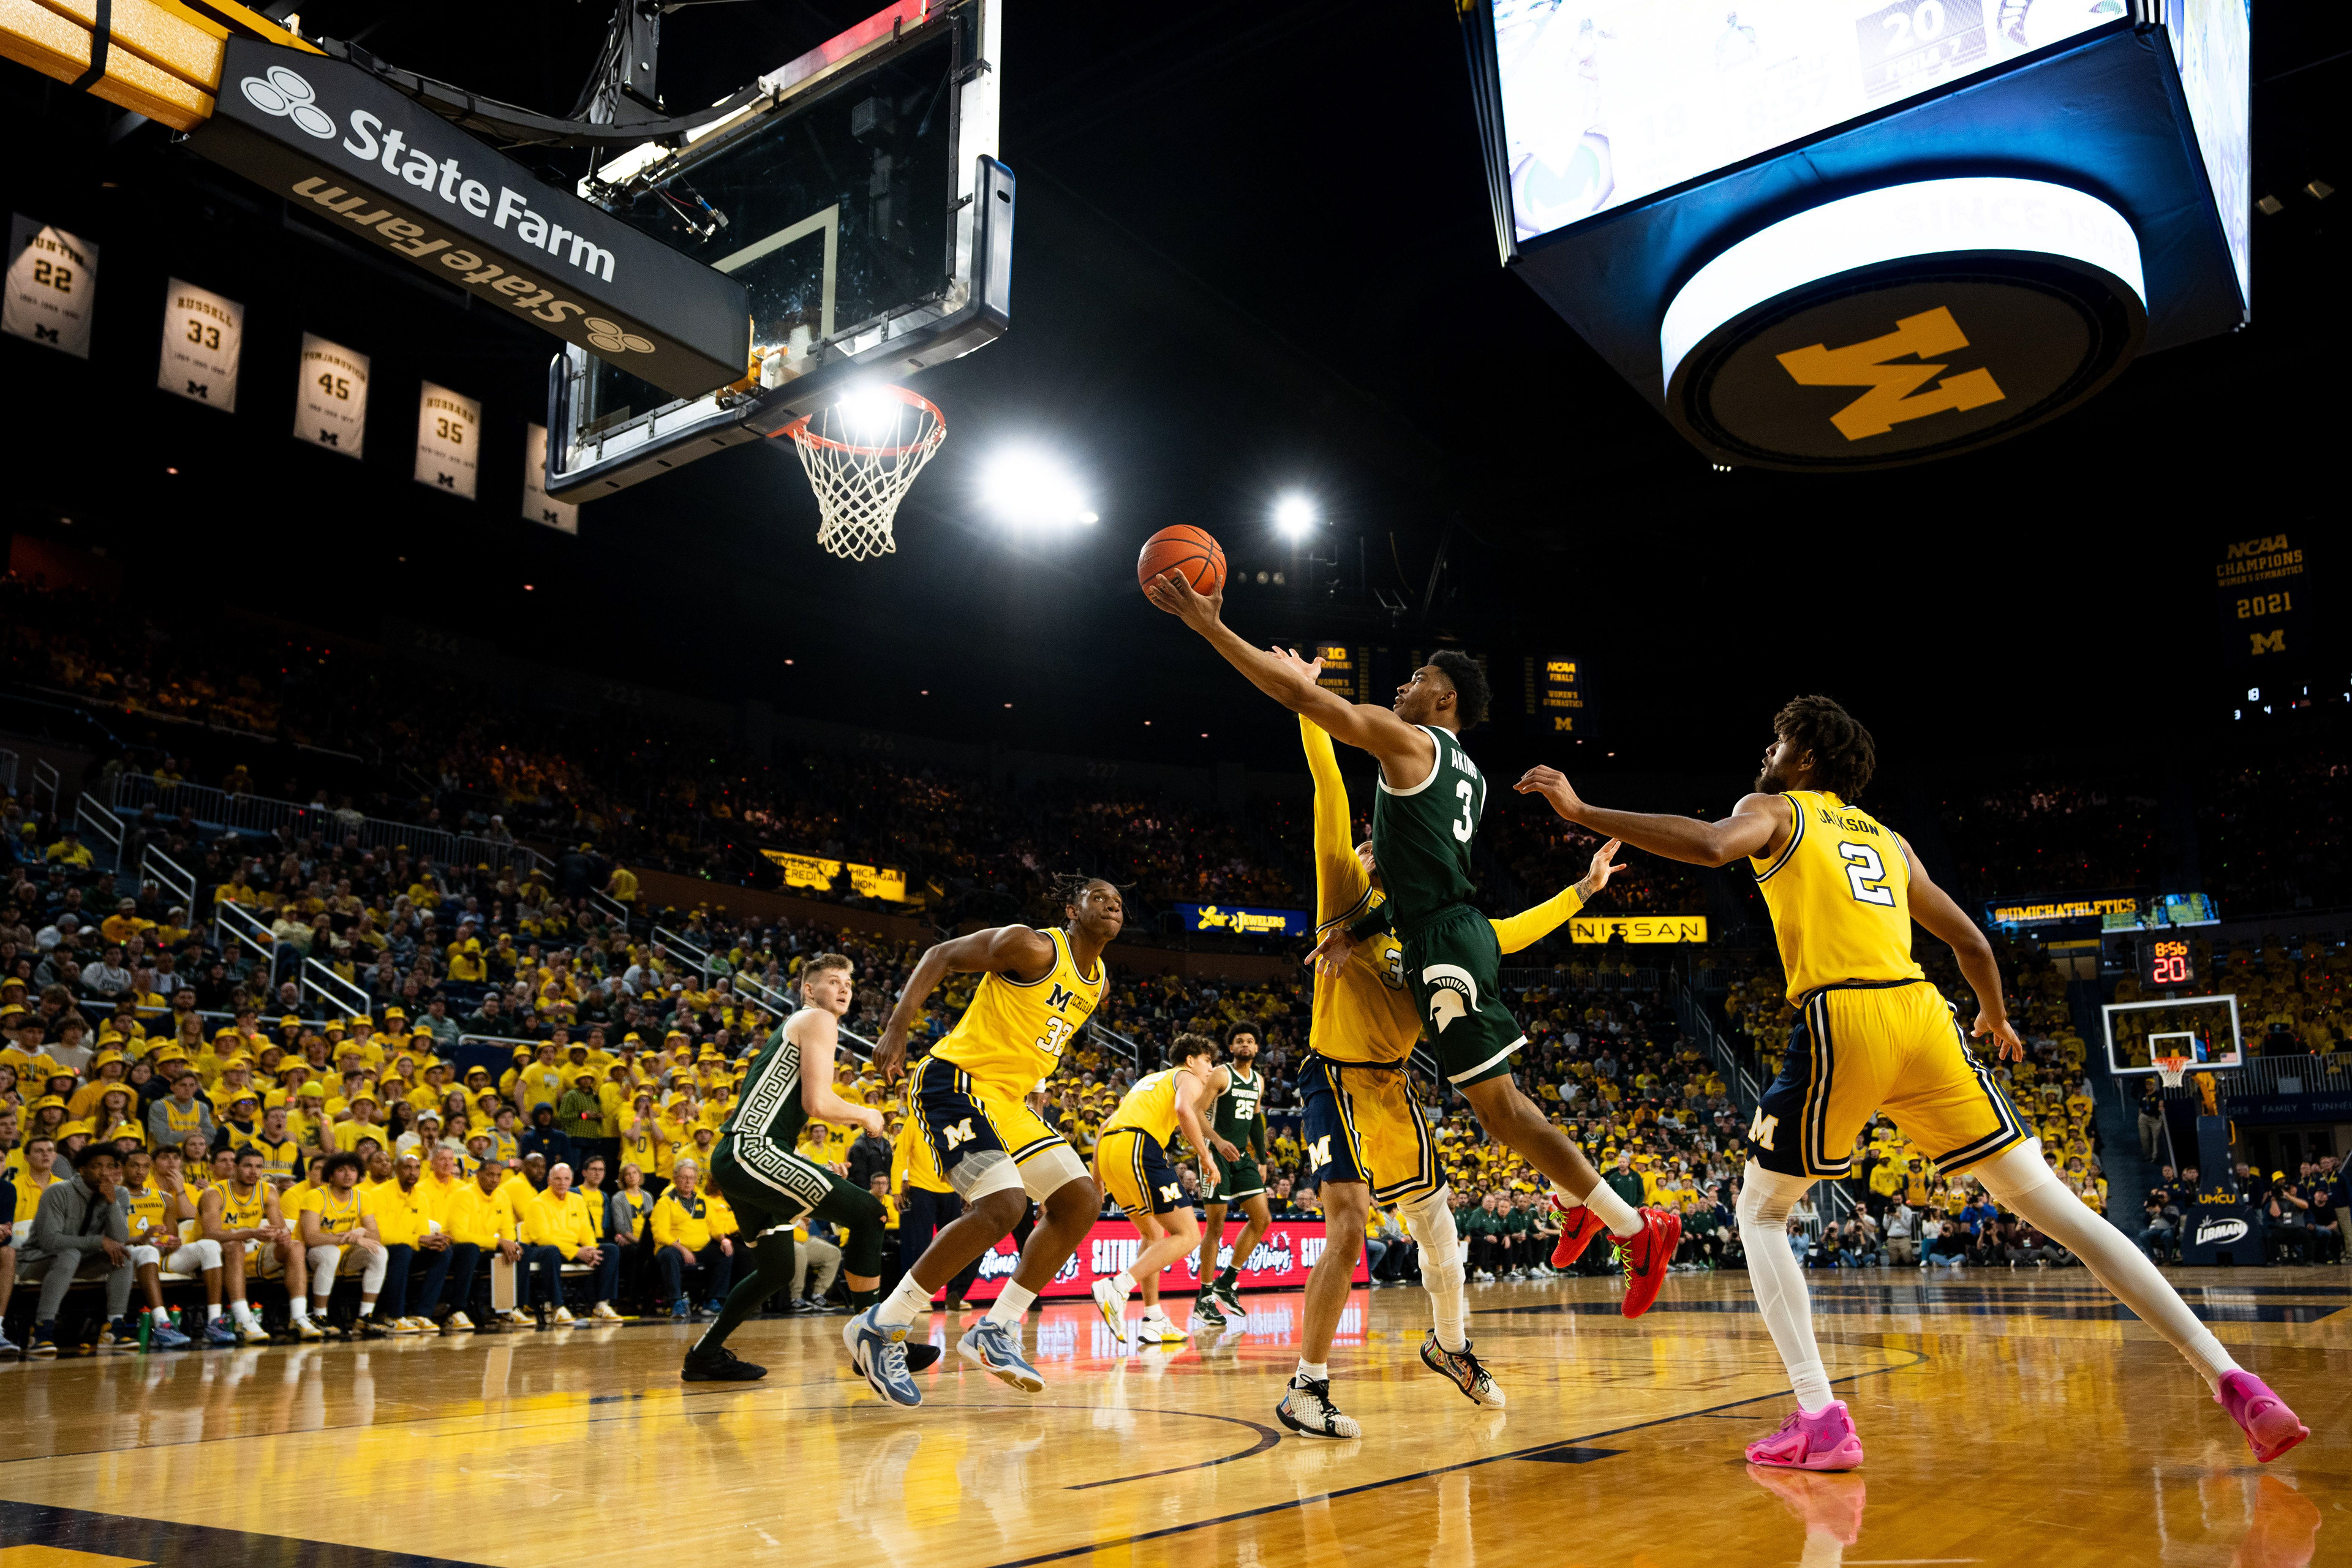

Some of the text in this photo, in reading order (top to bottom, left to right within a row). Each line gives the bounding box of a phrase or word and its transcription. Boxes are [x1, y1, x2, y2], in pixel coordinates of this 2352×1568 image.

[1882, 0, 1945, 56] 20
[33, 258, 72, 293] 22
[178, 296, 233, 328] RUSSELL
[34, 323, 59, 344] M
[187, 318, 221, 351] 33
[1776, 306, 2006, 441] M
[187, 379, 208, 399] M
[318, 372, 350, 401] 45
[320, 429, 338, 446] M
[435, 417, 463, 445] 35
[437, 472, 454, 488] M
[543, 508, 558, 524] M
[2226, 533, 2289, 560] NCAA
[2215, 549, 2304, 578] CHAMPIONS
[2236, 590, 2293, 620] 2021
[2249, 628, 2286, 656] M
[1547, 662, 1577, 673] NCAA
[1549, 673, 1575, 683] FINALS
[1553, 716, 1573, 731] M
[1452, 778, 1473, 843] 3
[1817, 807, 1880, 837] JACKSON
[784, 868, 876, 891] CREDIT NION
[1837, 840, 1897, 908] 2
[1995, 898, 2136, 922] @UMICHATHLETICS
[1577, 923, 1698, 938] NISSAN
[2155, 941, 2188, 957] 8:56
[2154, 956, 2187, 984] 20
[1231, 1088, 1259, 1101] SPARTANS
[1235, 1099, 1256, 1120] 25
[2262, 1104, 2298, 1114] FAMILY
[943, 1117, 977, 1152] M
[1748, 1105, 1779, 1152] M
[1308, 1134, 1332, 1174] M
[1159, 1181, 1183, 1204] M
[2199, 1194, 2236, 1205] UMCU
[135, 1216, 150, 1232] 4
[2196, 1226, 2243, 1246] LIBMAN
